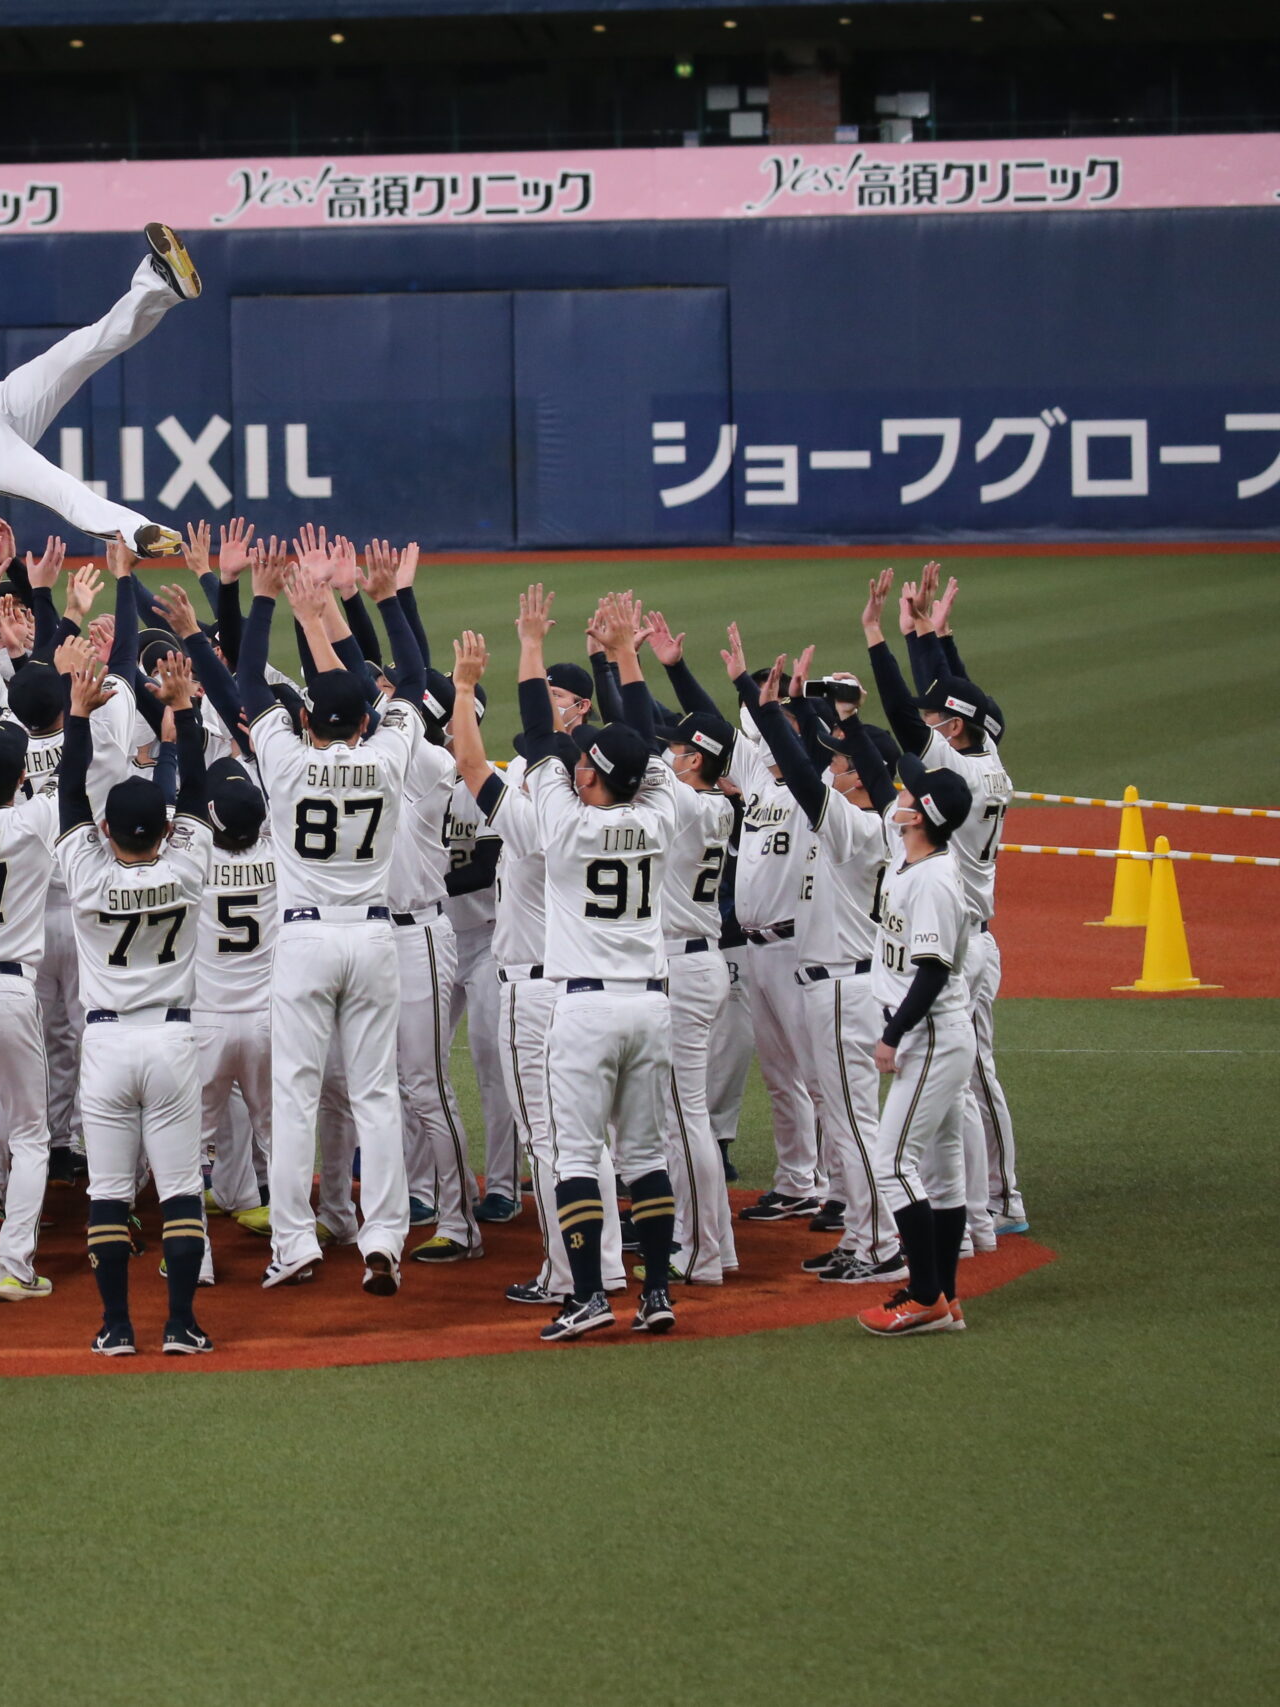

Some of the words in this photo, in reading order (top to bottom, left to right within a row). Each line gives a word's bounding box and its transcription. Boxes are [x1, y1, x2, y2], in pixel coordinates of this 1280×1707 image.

[328, 172, 591, 219] 高須クリニック
[857, 158, 1120, 207] 高須クリニック
[60, 414, 332, 511] LIXIL
[307, 764, 376, 787] SAITOH
[294, 797, 384, 862] 87
[604, 828, 647, 851] IIDA
[108, 883, 176, 911] SOYOGI
[584, 857, 653, 919] 91
[98, 905, 188, 967] 77
[216, 894, 261, 954] 5
[914, 933, 939, 944] FWD
[570, 1232, 585, 1249] B
